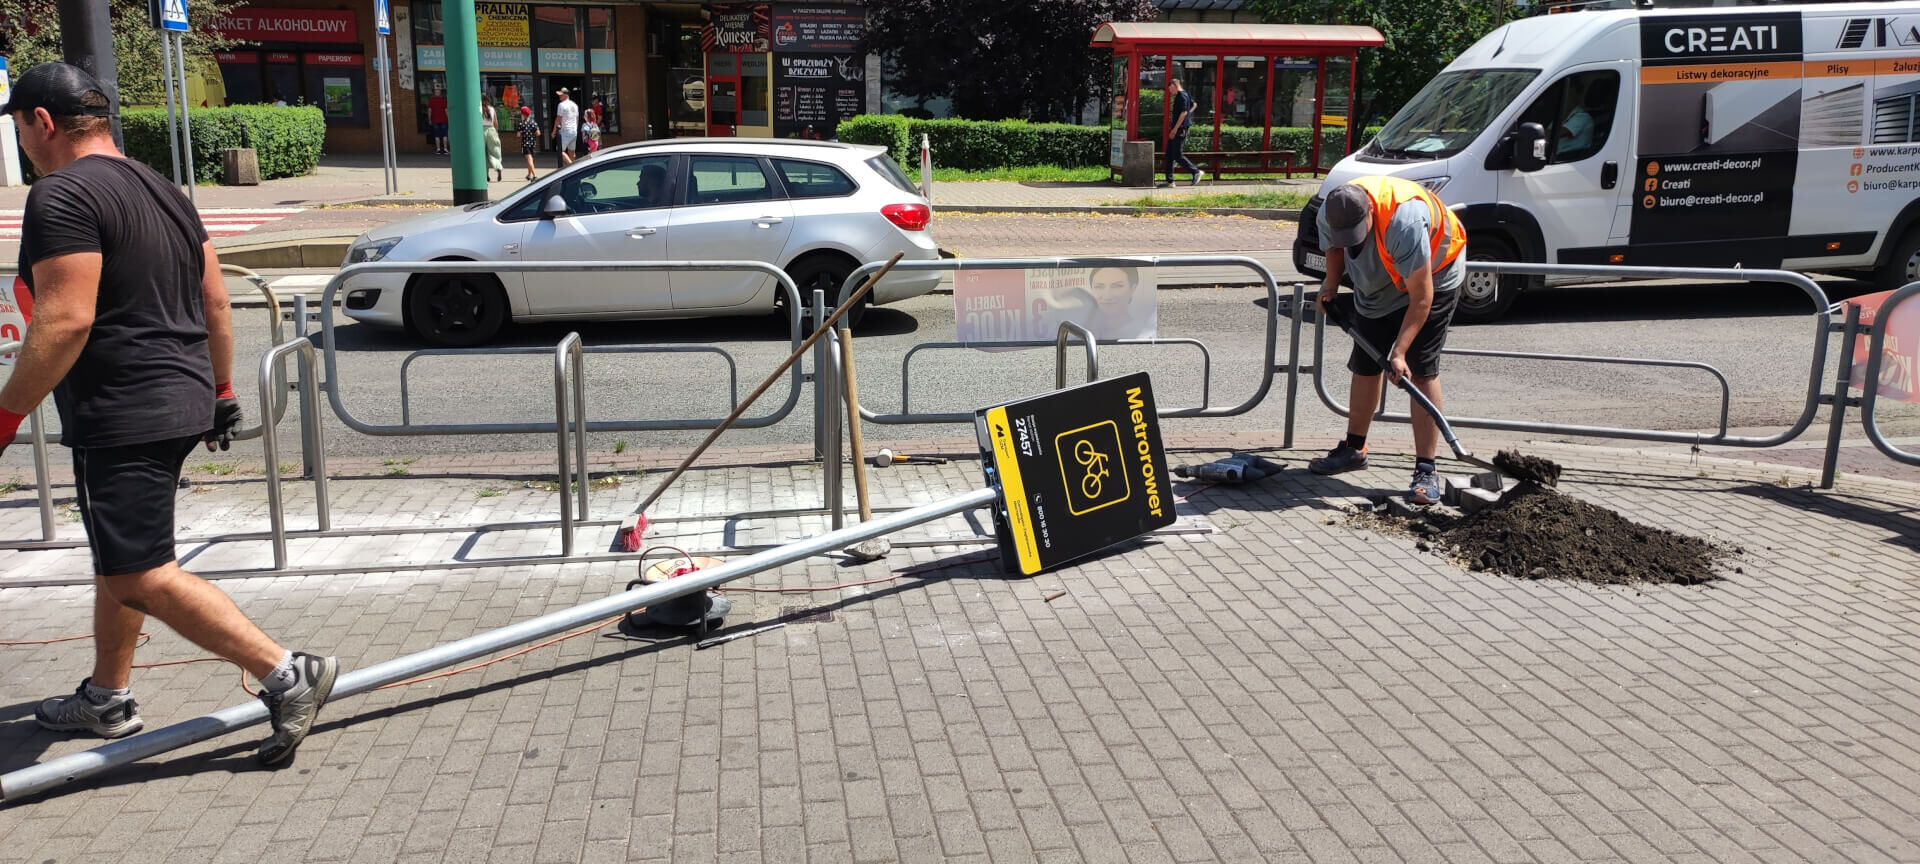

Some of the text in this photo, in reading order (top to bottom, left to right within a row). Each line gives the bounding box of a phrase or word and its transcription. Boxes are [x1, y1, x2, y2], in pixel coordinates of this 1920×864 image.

[474, 4, 528, 15] PRALNIA
[719, 13, 750, 22] DELIKATESY
[200, 17, 348, 33] MARKET ALKOHOLOWY
[715, 26, 756, 47] Koneser
[1664, 25, 1777, 53] CREATI
[318, 55, 352, 63] PAPIEROSY
[483, 51, 523, 60] OBUWIE
[782, 57, 833, 68] W SPRZEDAŻY
[788, 67, 828, 76] DZICZYZNA
[1676, 67, 1769, 81] Listwy dekoracyjne
[1827, 64, 1849, 75] Plisy
[1664, 158, 1761, 173] www.creati-decor.pl
[1662, 179, 1691, 190] Creati
[1660, 192, 1764, 207] biuro@creati-decor.pl
[1015, 417, 1033, 457] 27457
[1125, 386, 1162, 518] Metrorower
[1036, 505, 1050, 548] 800 16 30 30
